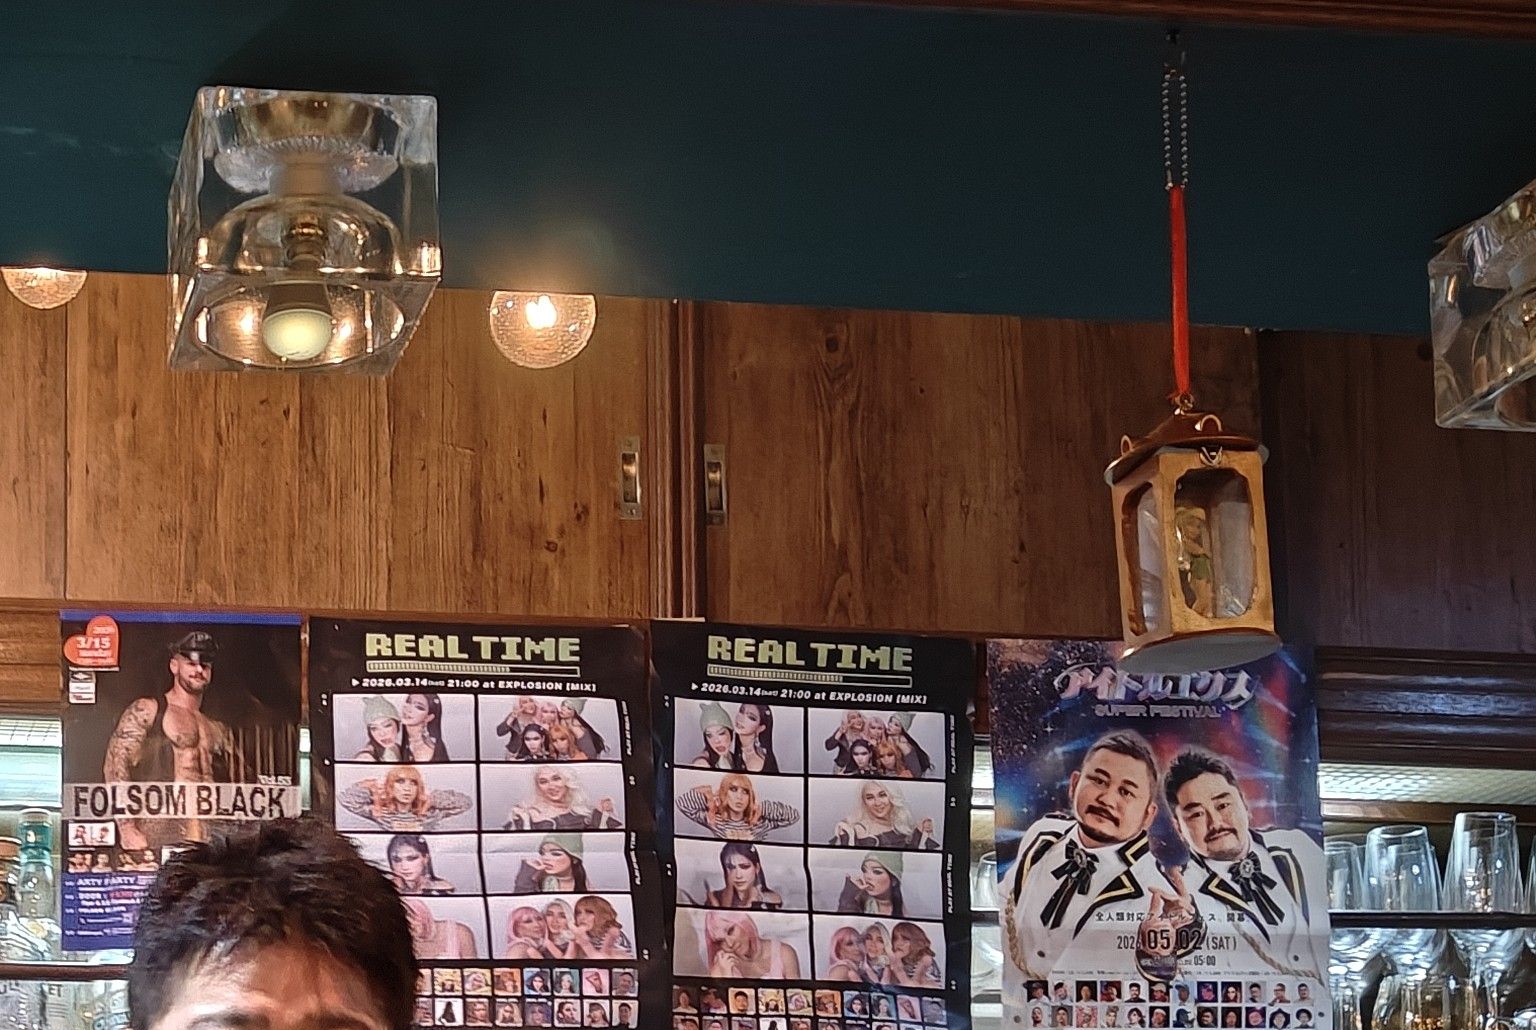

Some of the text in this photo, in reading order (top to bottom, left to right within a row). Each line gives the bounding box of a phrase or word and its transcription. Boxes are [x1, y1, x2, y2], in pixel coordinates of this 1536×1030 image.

[76, 636, 111, 649] 3/15
[447, 679, 480, 688] 21:00
[482, 680, 495, 688] at
[498, 680, 563, 691] EXPLOSION
[780, 689, 812, 699] 21:00
[814, 691, 826, 700] at
[829, 692, 892, 703] EXPLOSION
[1094, 705, 1222, 718] SUPER FESTIVAL
[74, 784, 286, 818] FOLSOM BLACK
[1205, 936, 1237, 950] (SAT)
[1193, 956, 1216, 966] 05:00
